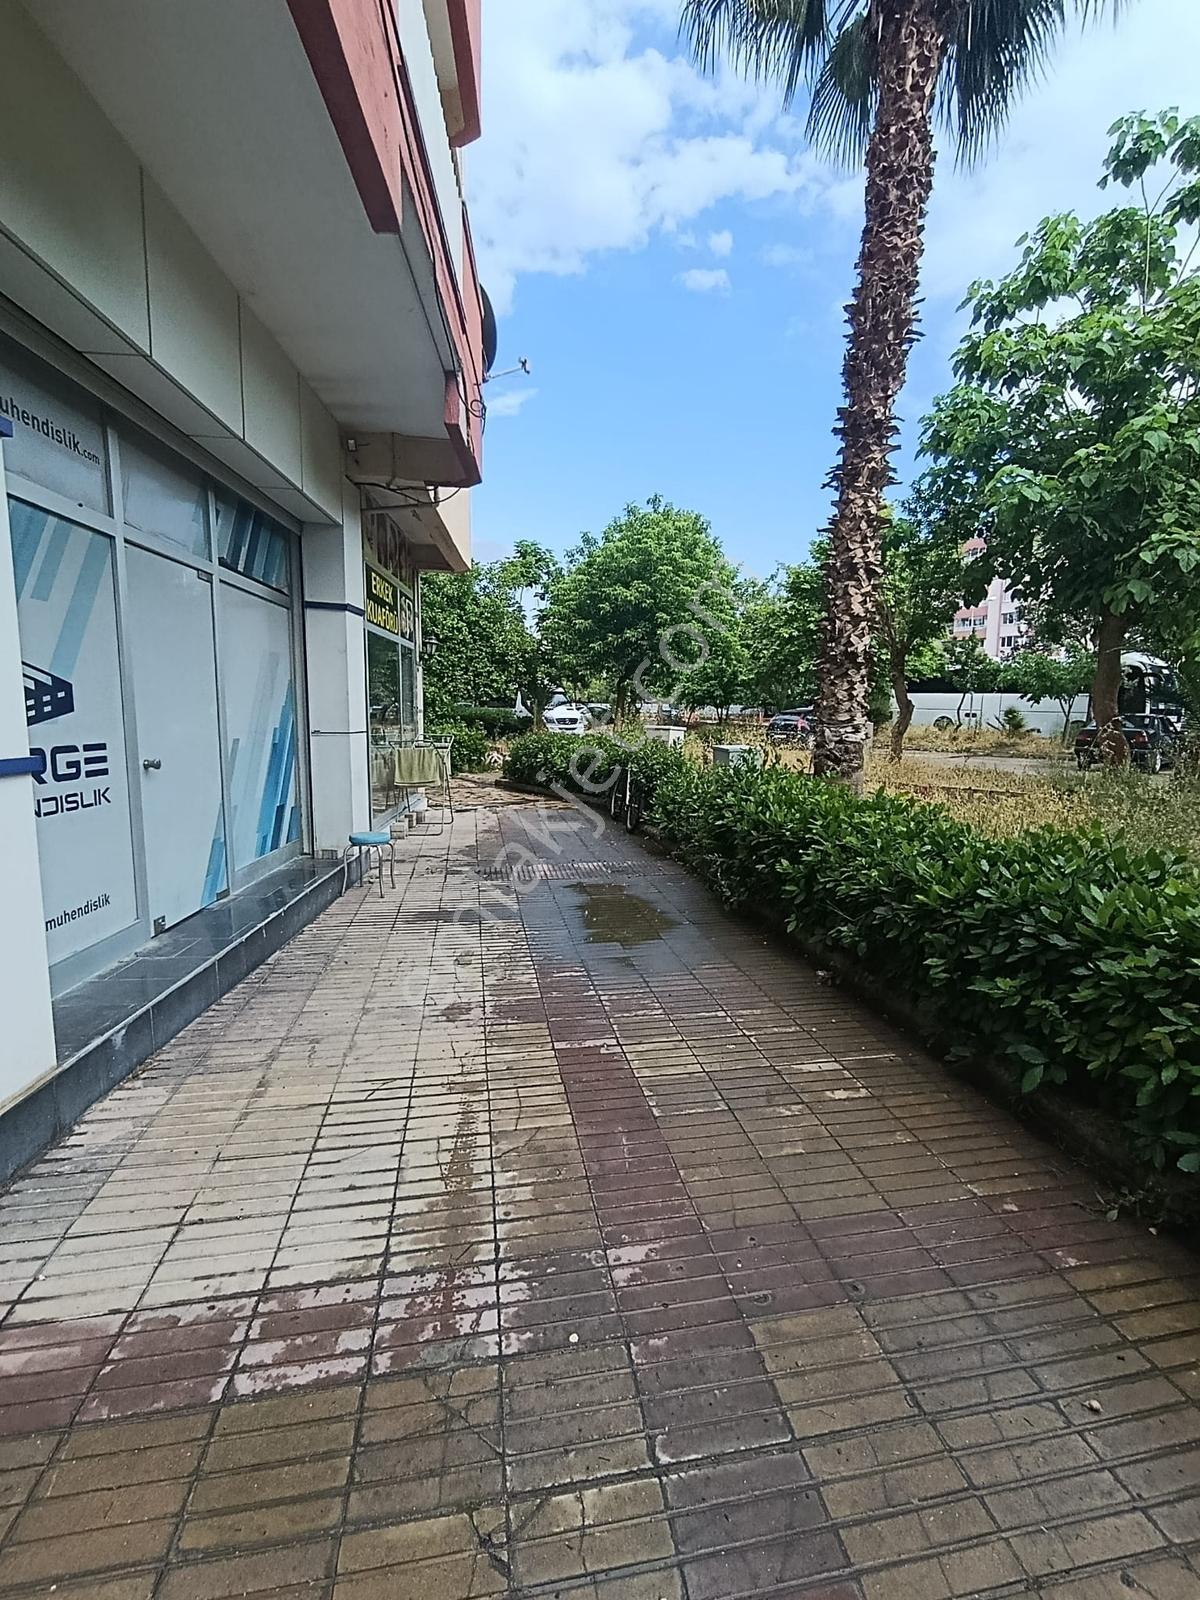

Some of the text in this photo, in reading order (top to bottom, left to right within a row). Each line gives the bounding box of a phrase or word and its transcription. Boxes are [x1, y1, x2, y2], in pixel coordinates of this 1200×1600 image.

[371, 571, 394, 606] ERKEK
[366, 598, 399, 634] KUAFÖRÜ
[45, 893, 110, 932] muhendislik
